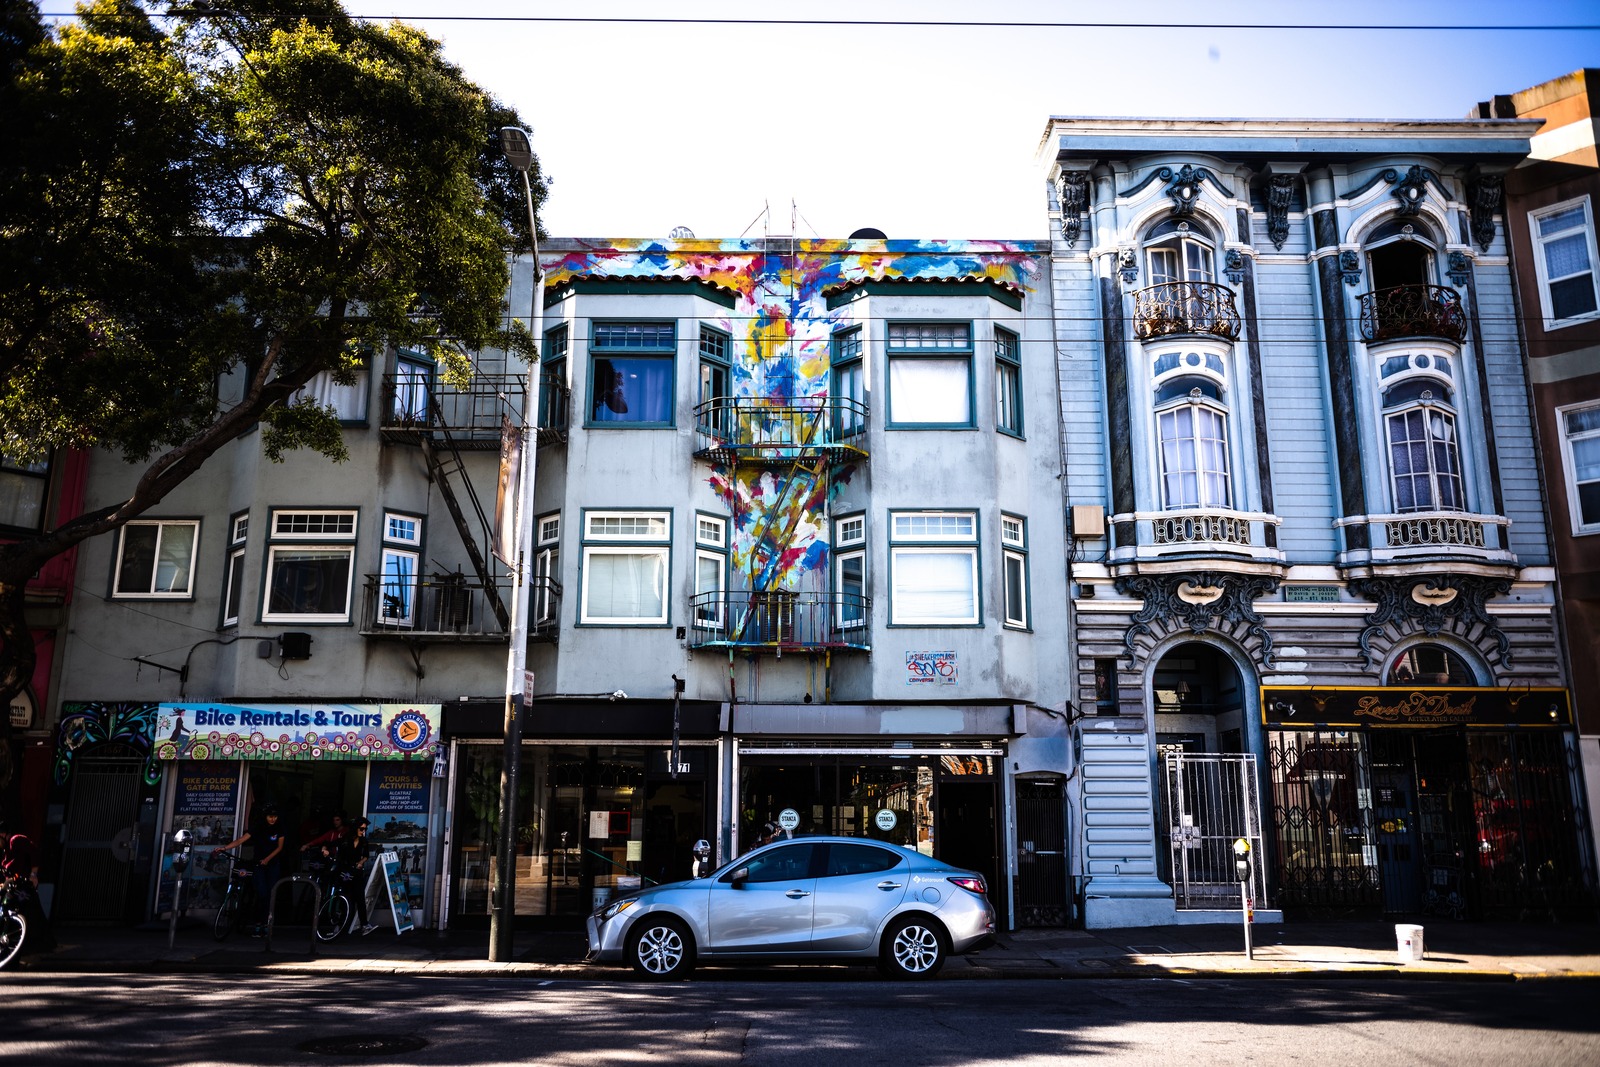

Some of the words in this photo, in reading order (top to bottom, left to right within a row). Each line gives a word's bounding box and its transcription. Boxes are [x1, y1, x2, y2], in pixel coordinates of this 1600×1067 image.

[1354, 696, 1402, 720] Loved
[1426, 694, 1477, 716] Death
[195, 708, 236, 726] Bike
[240, 709, 310, 726] Rentals
[313, 711, 328, 726] &
[332, 710, 383, 727] Tours
[393, 718, 402, 729] BAY
[416, 716, 426, 729] BIKE
